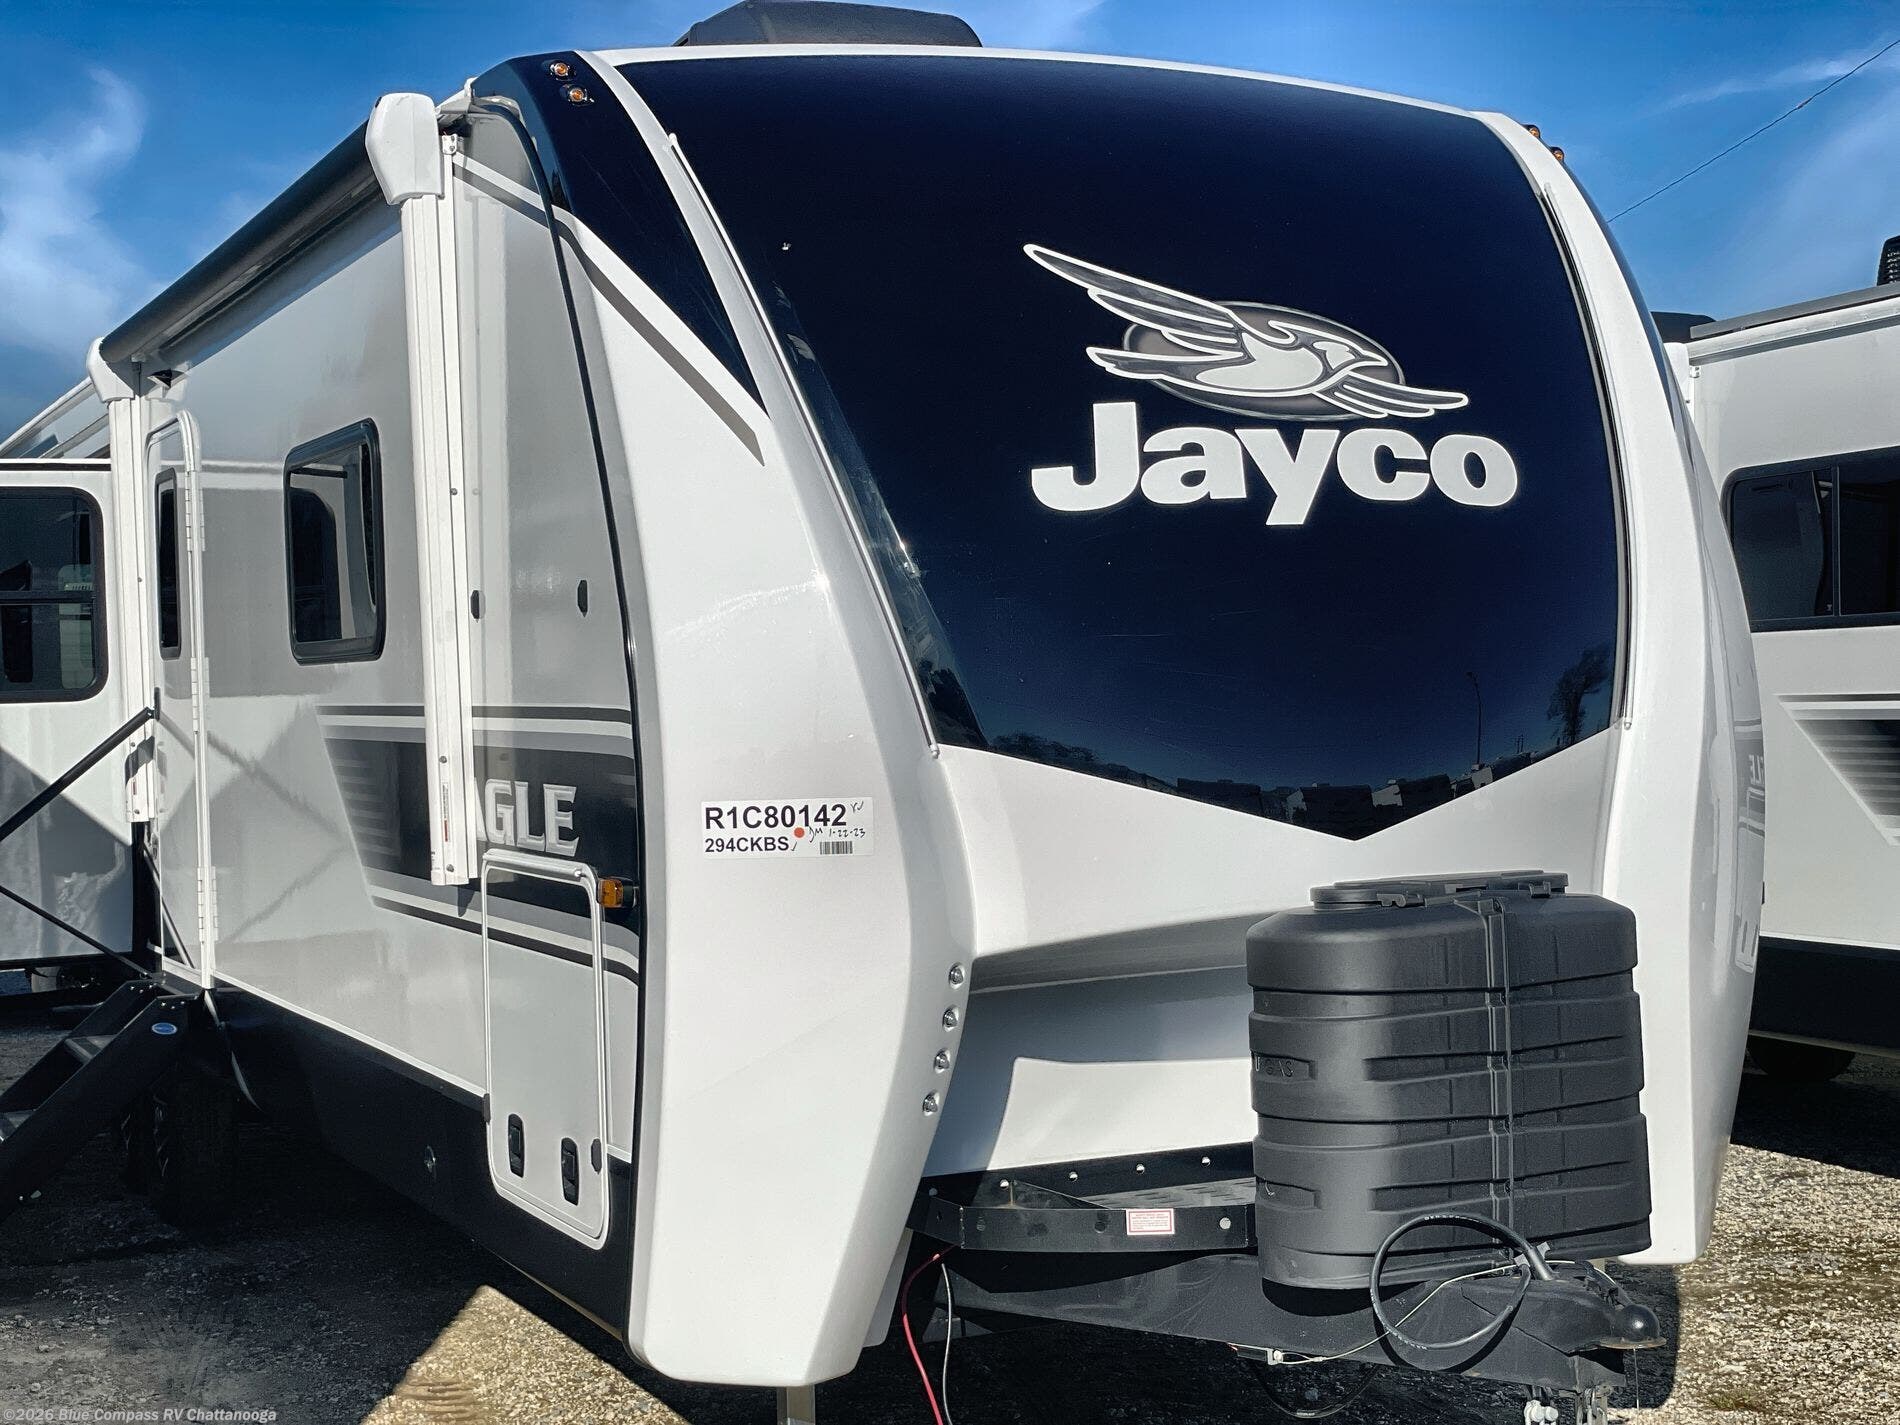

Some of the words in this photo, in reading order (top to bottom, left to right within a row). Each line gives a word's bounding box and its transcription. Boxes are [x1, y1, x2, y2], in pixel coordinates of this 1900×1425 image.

[1031, 401, 1518, 526] Jayco
[705, 804, 847, 829] R1C80142
[705, 836, 790, 852] 294CKBS
